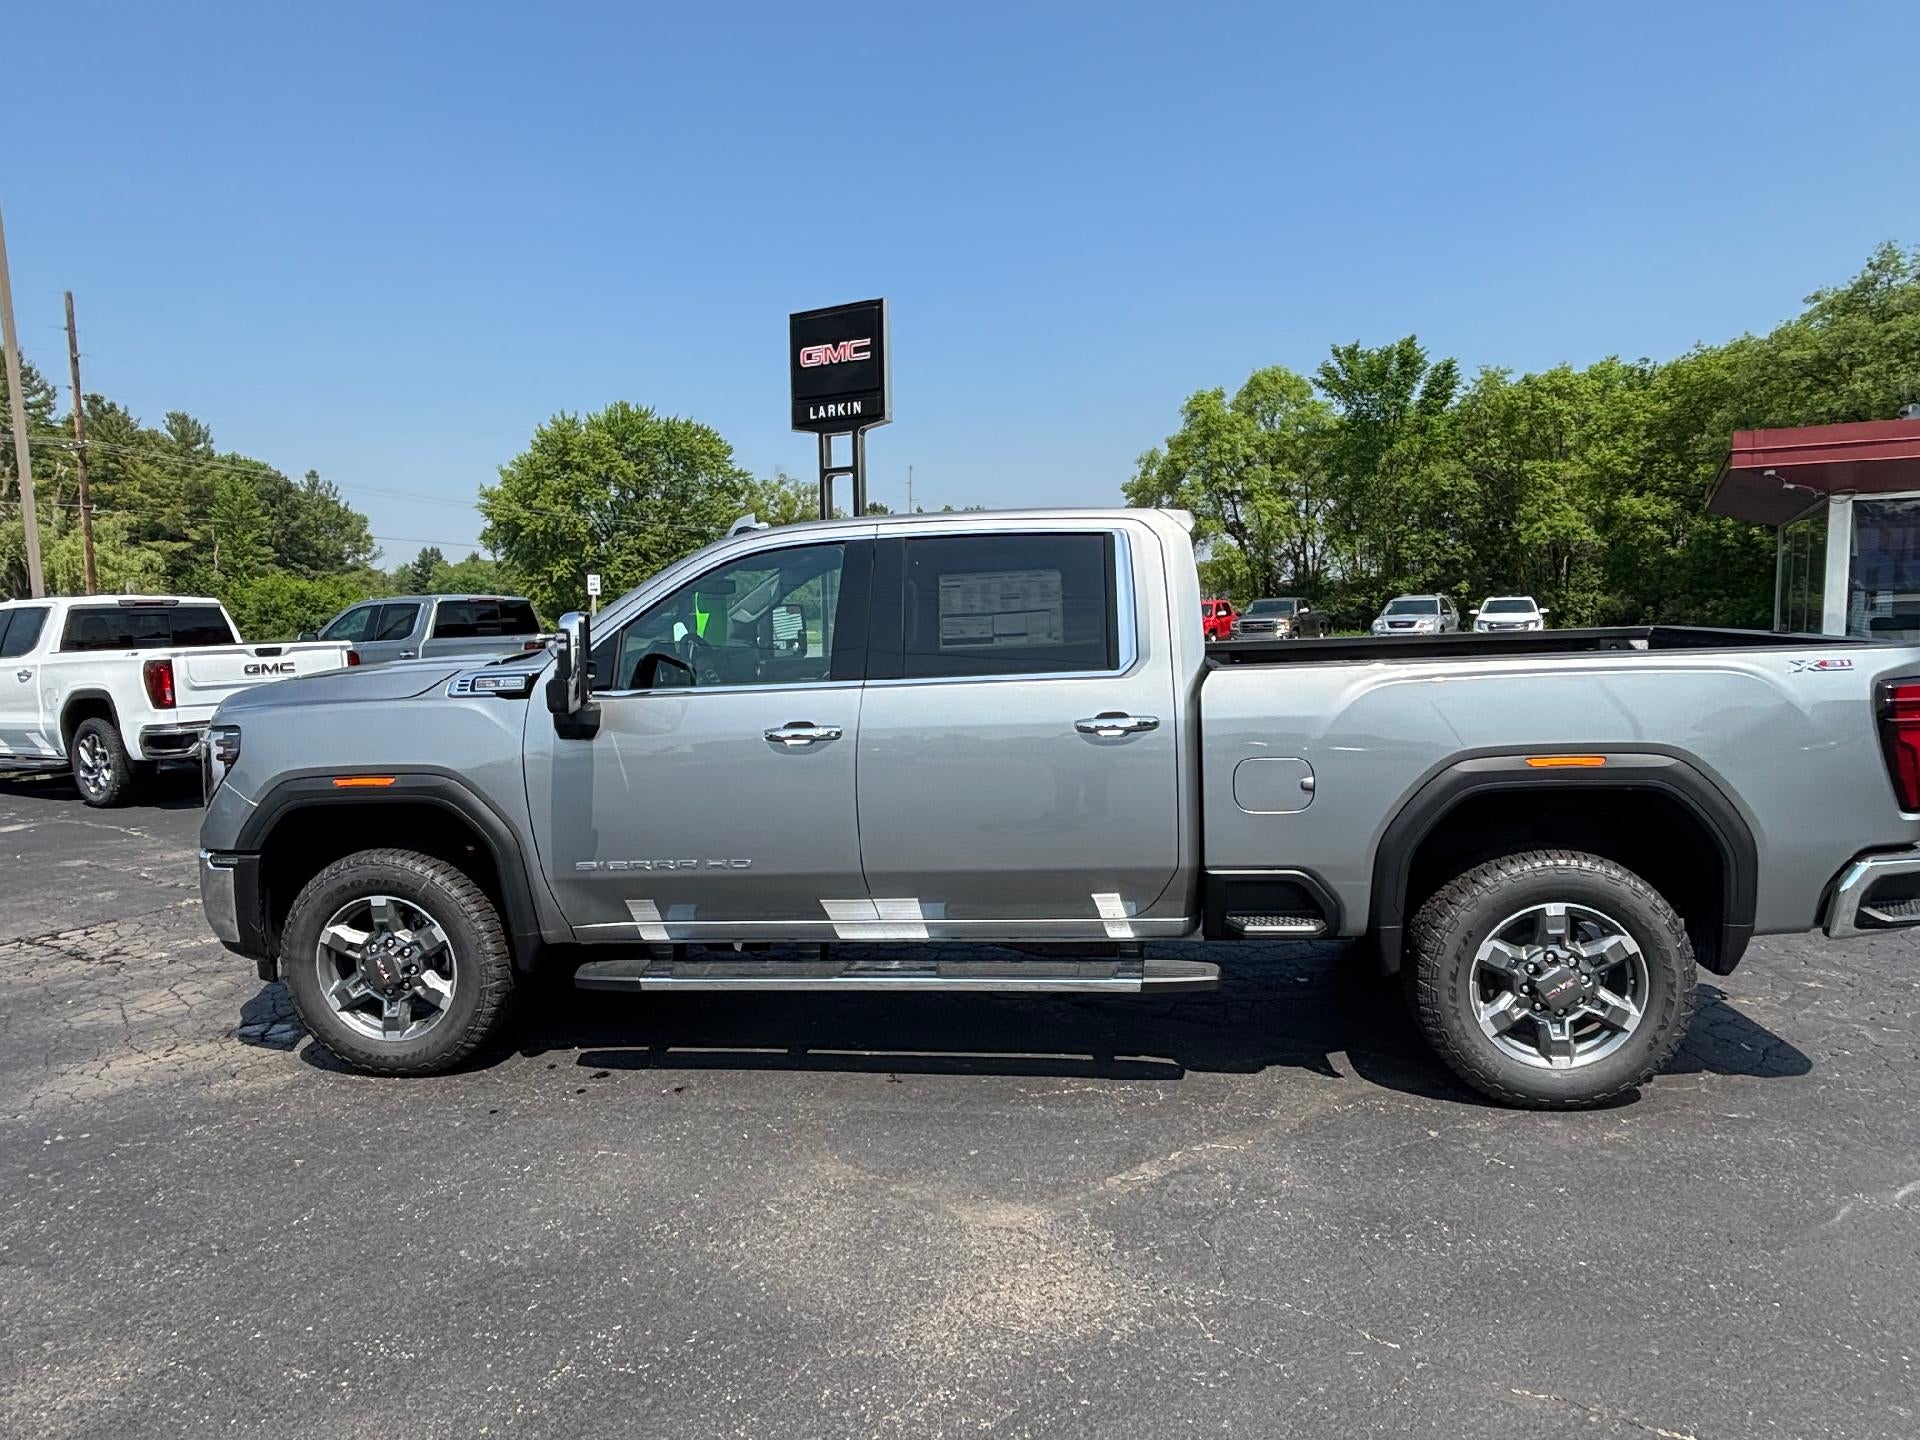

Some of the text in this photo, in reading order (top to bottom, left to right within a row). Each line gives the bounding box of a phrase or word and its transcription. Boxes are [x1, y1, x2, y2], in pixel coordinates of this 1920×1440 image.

[800, 338, 871, 368] GMC
[809, 401, 862, 420] LARKIN
[244, 661, 296, 675] GMC
[575, 859, 752, 871] SIERRA HD
